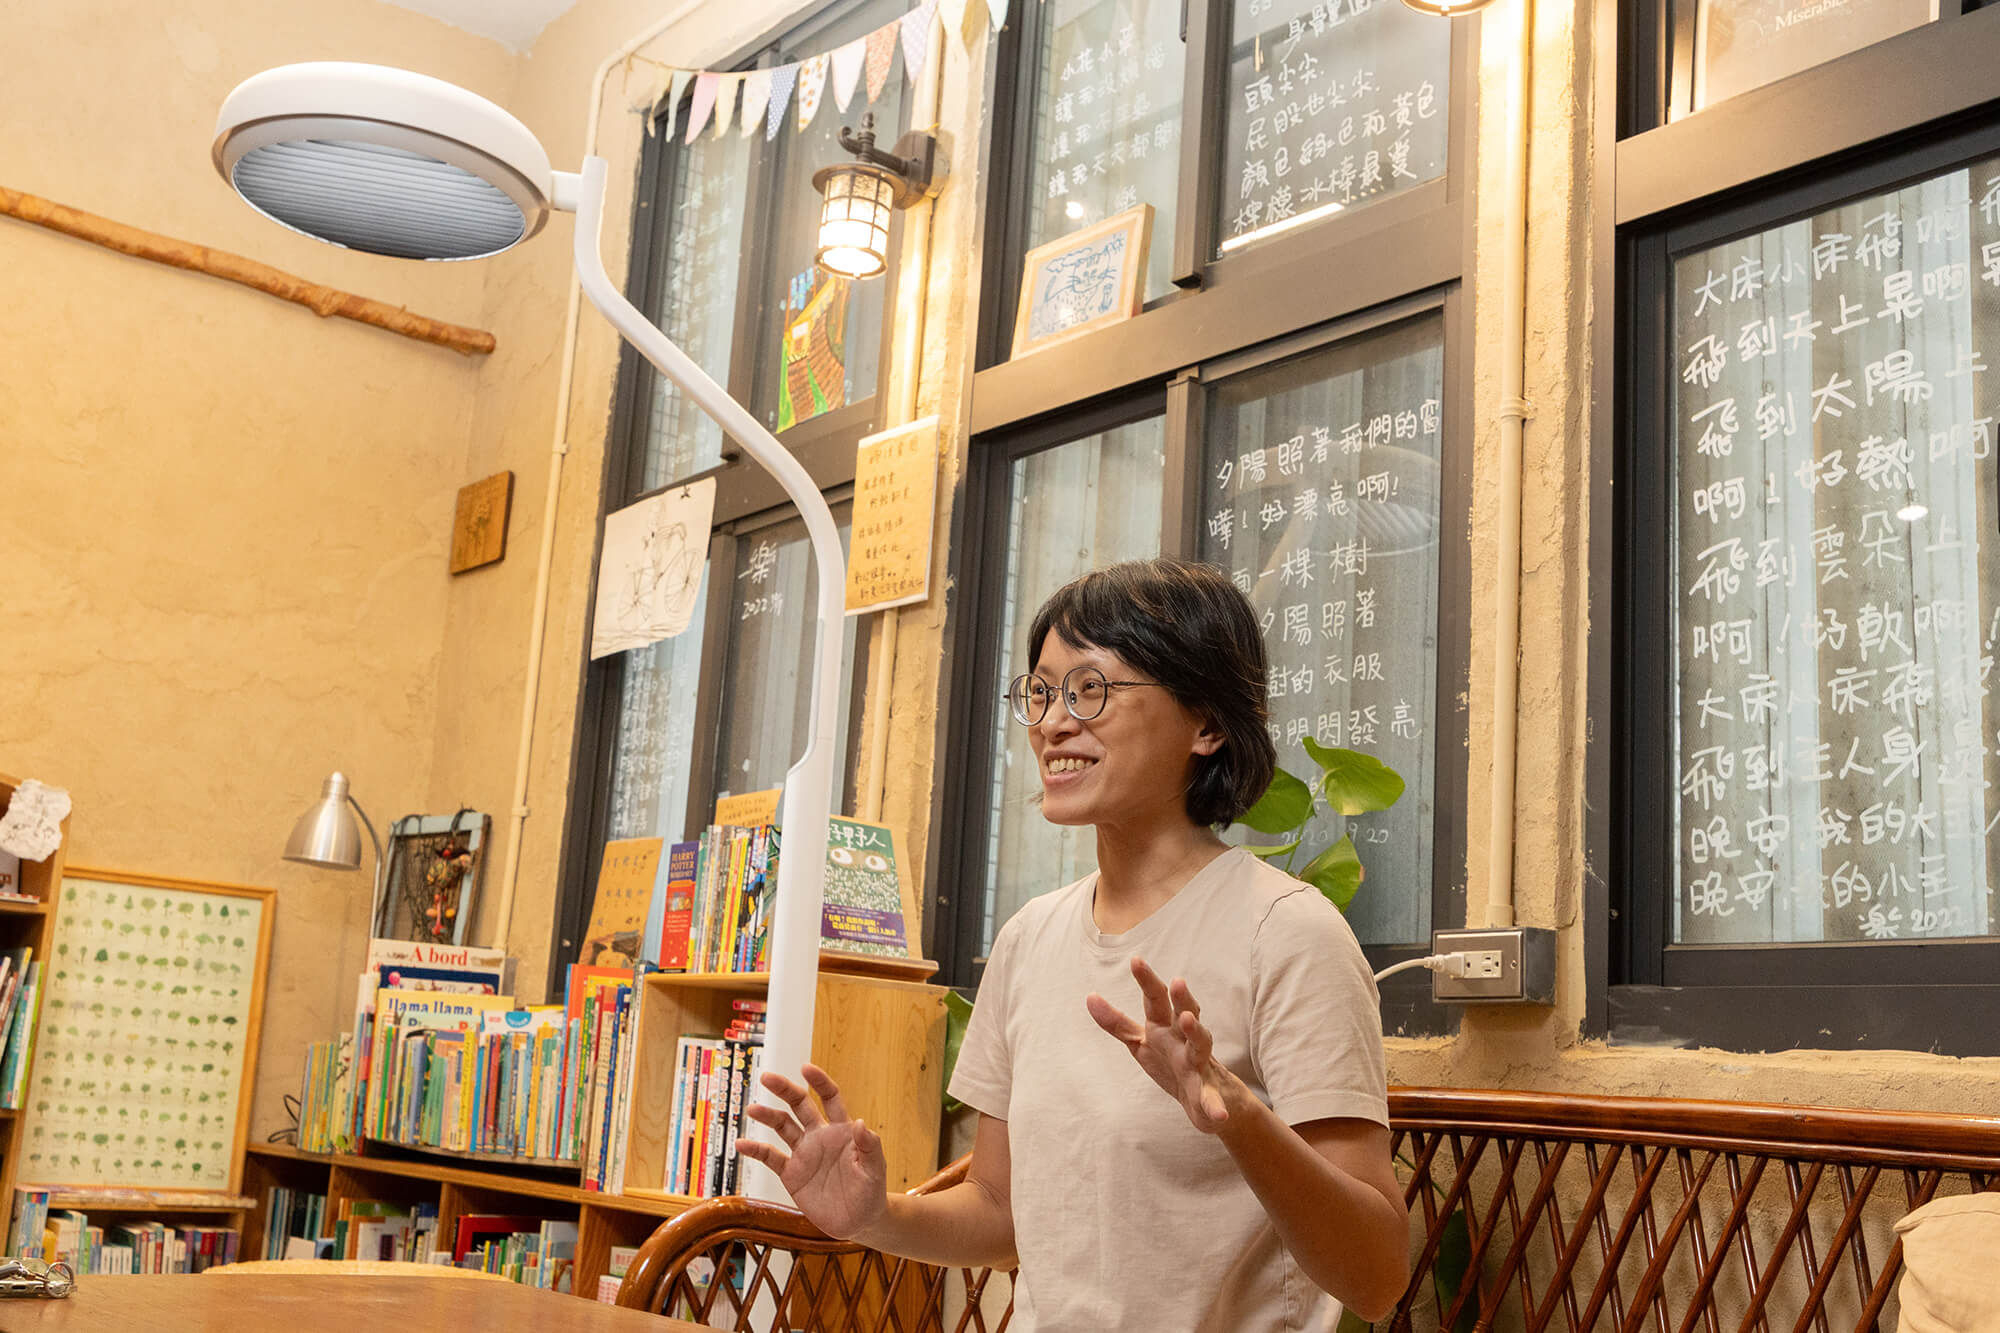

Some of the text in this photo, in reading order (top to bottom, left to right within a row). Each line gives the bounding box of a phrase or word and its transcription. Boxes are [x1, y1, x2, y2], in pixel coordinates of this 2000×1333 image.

[1690, 343, 1988, 458] 飛到太陽上
[409, 945, 468, 967] A bord
[388, 997, 474, 1016] llama llama
